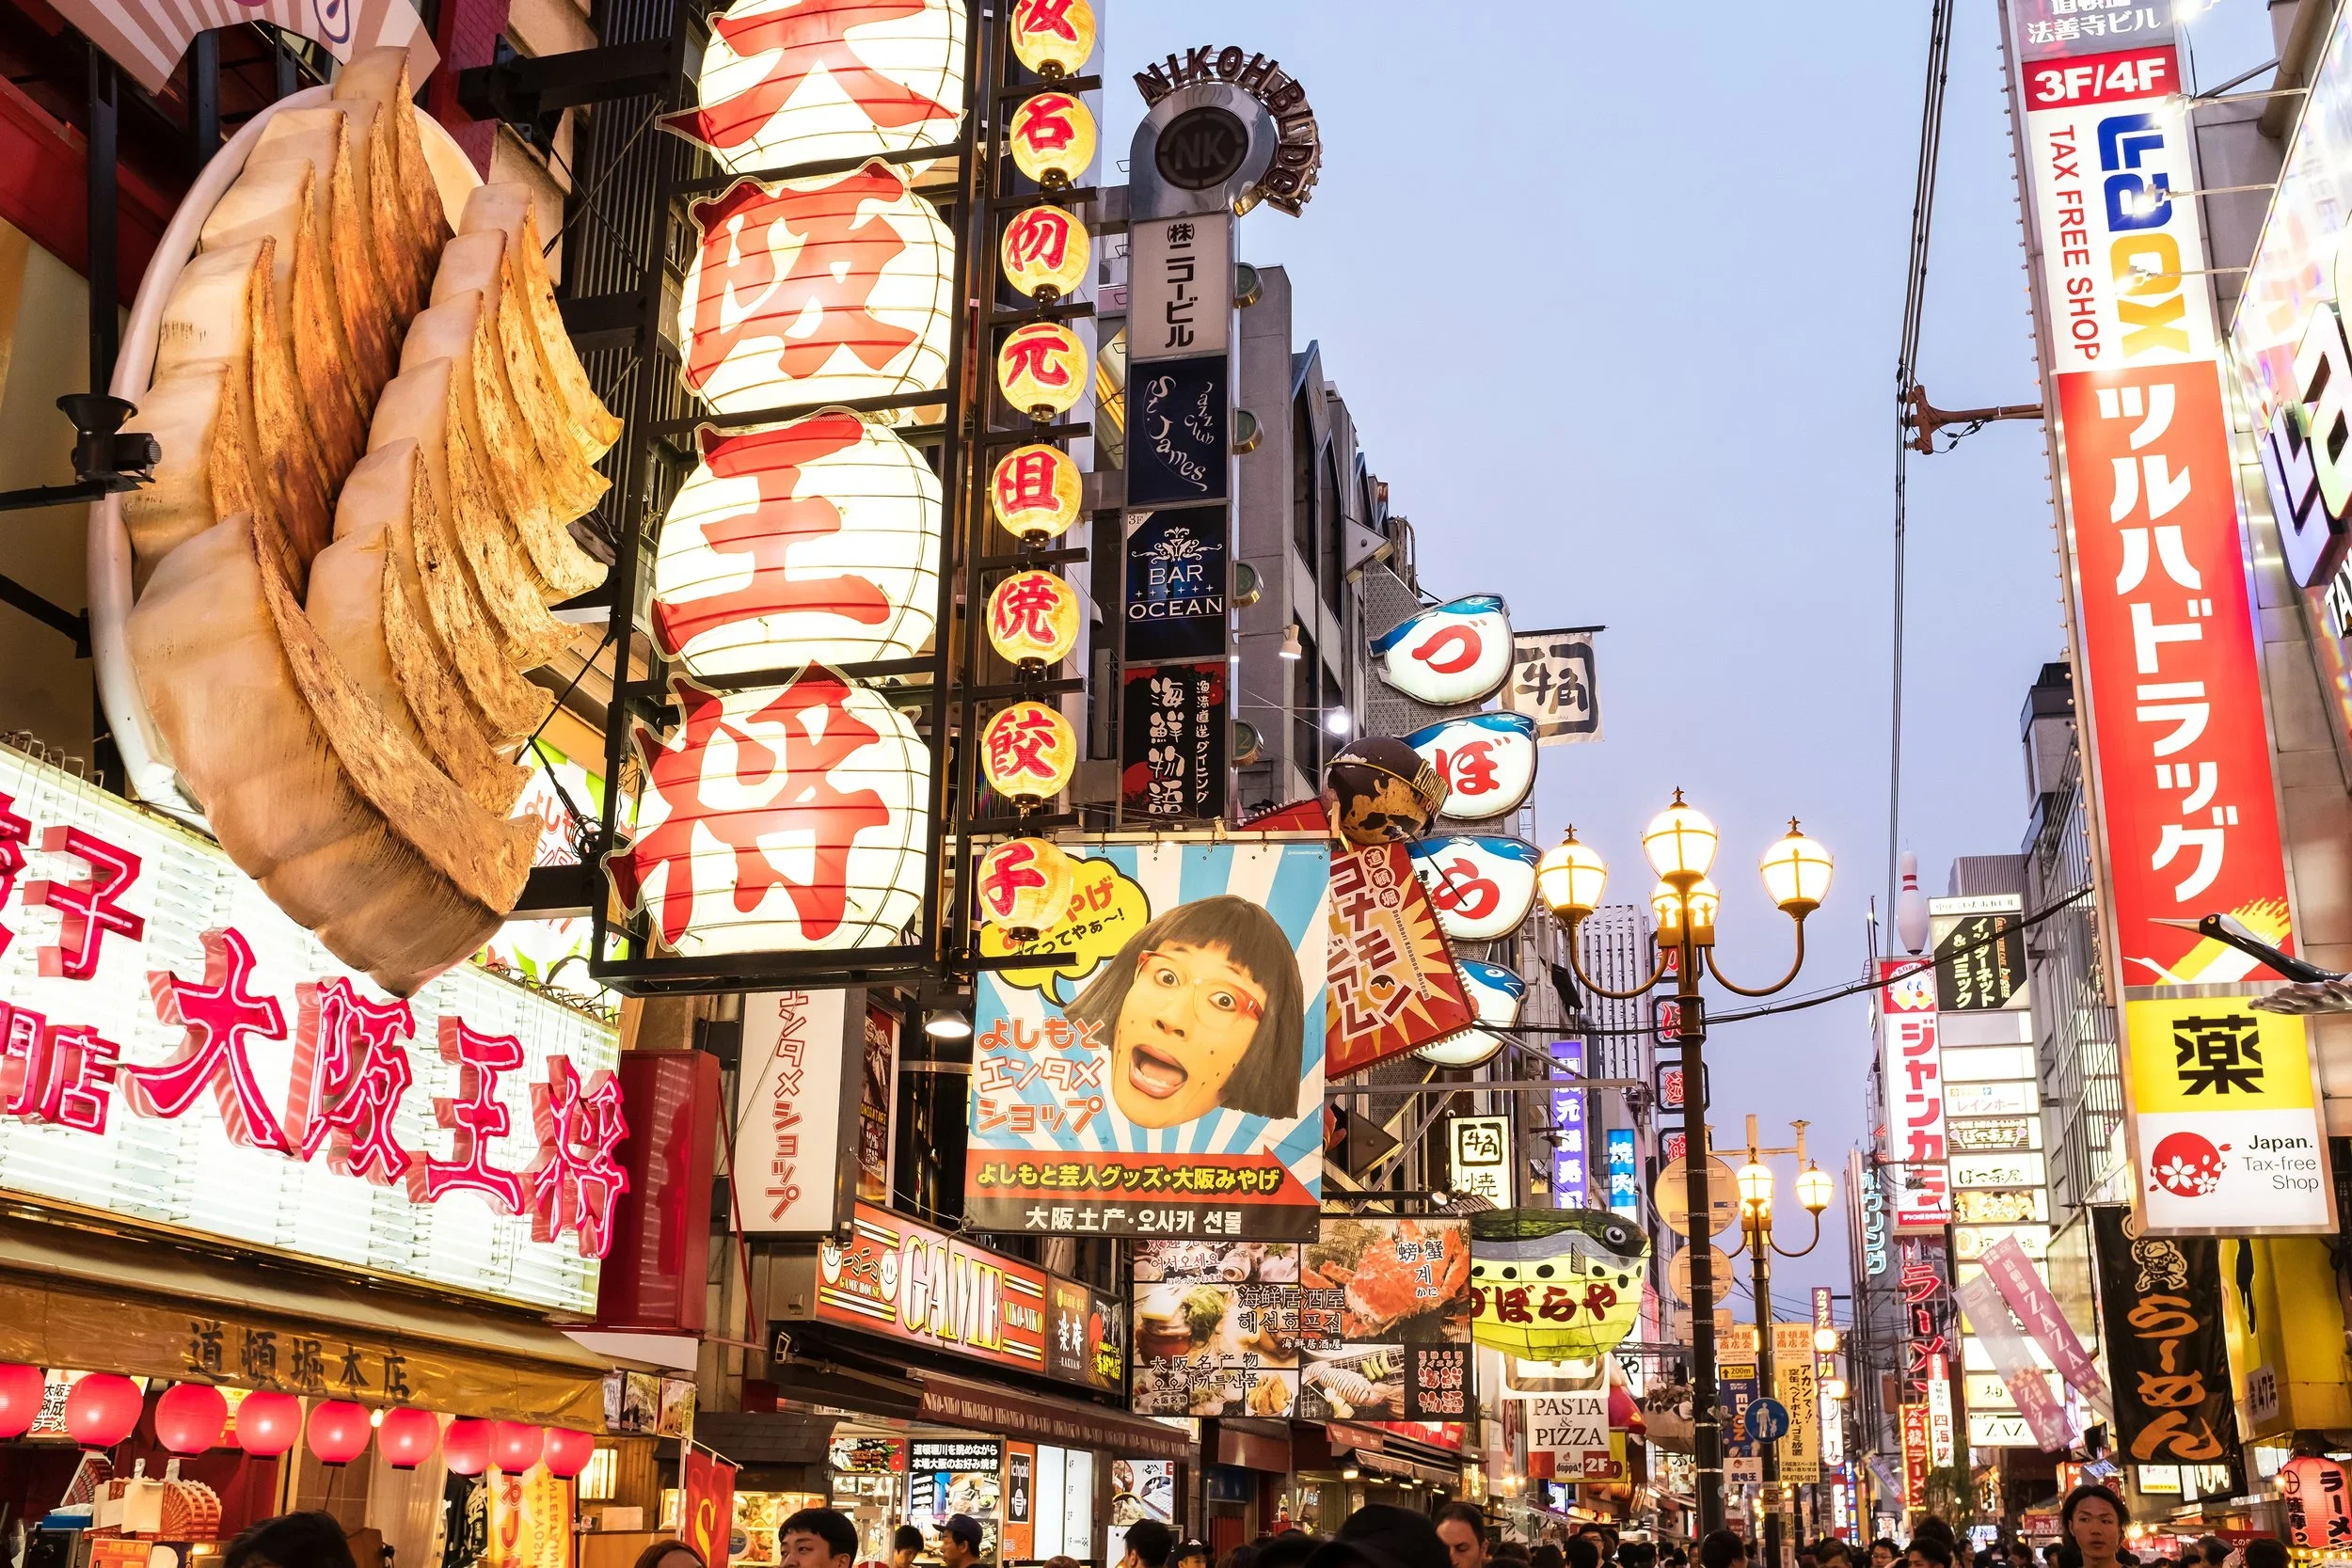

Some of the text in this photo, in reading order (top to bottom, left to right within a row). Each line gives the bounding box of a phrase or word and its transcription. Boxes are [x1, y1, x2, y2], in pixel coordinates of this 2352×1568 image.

[2027, 8, 2161, 44] 法善寺ビル
[1133, 44, 1279, 109] NIKOH
[2035, 57, 2167, 103] 3F/4F
[1176, 129, 1228, 170] NK
[2049, 125, 2102, 361] TAX FREE SHOP
[1149, 563, 1204, 587] BAR
[1129, 596, 1223, 621] OCEAN
[2095, 383, 2239, 903] ツルハドラッグ
[1149, 676, 1185, 816] 海鮮物語
[977, 1017, 1104, 1053] よしもと
[2172, 1014, 2265, 1096] 薬
[979, 1055, 1105, 1093] エンタメ
[976, 1095, 1104, 1134] ショップ
[2248, 1134, 2314, 1152] Japan.
[1609, 1141, 1635, 1196] 焼肉
[2242, 1156, 2317, 1172] Tax-free
[2272, 1175, 2320, 1193] Shop
[1203, 1210, 1243, 1234] 선물
[1152, 1252, 1221, 1273] 어서오세요
[1397, 1239, 1444, 1263] 螃蟹
[1414, 1262, 1433, 1285] 계
[839, 1276, 881, 1300] GAME HOUSE
[899, 1234, 1003, 1352] GAME
[1415, 1285, 1438, 1298] かに
[1004, 1300, 1043, 1335] NIKO-NIKO
[1238, 1311, 1343, 1335] 해선호프집
[190, 1318, 411, 1404] 道頓堀本店
[1731, 1367, 1752, 1375] 200m
[1151, 1373, 1260, 1392] 오오사까특산품
[2127, 1292, 2224, 1461] らーめん
[1152, 1395, 1188, 1406] 大阪名物
[1533, 1398, 1604, 1417] PASTA
[1559, 1417, 1573, 1427] &
[1534, 1428, 1605, 1447] PIZZA
[1584, 1458, 1609, 1473] 2F
